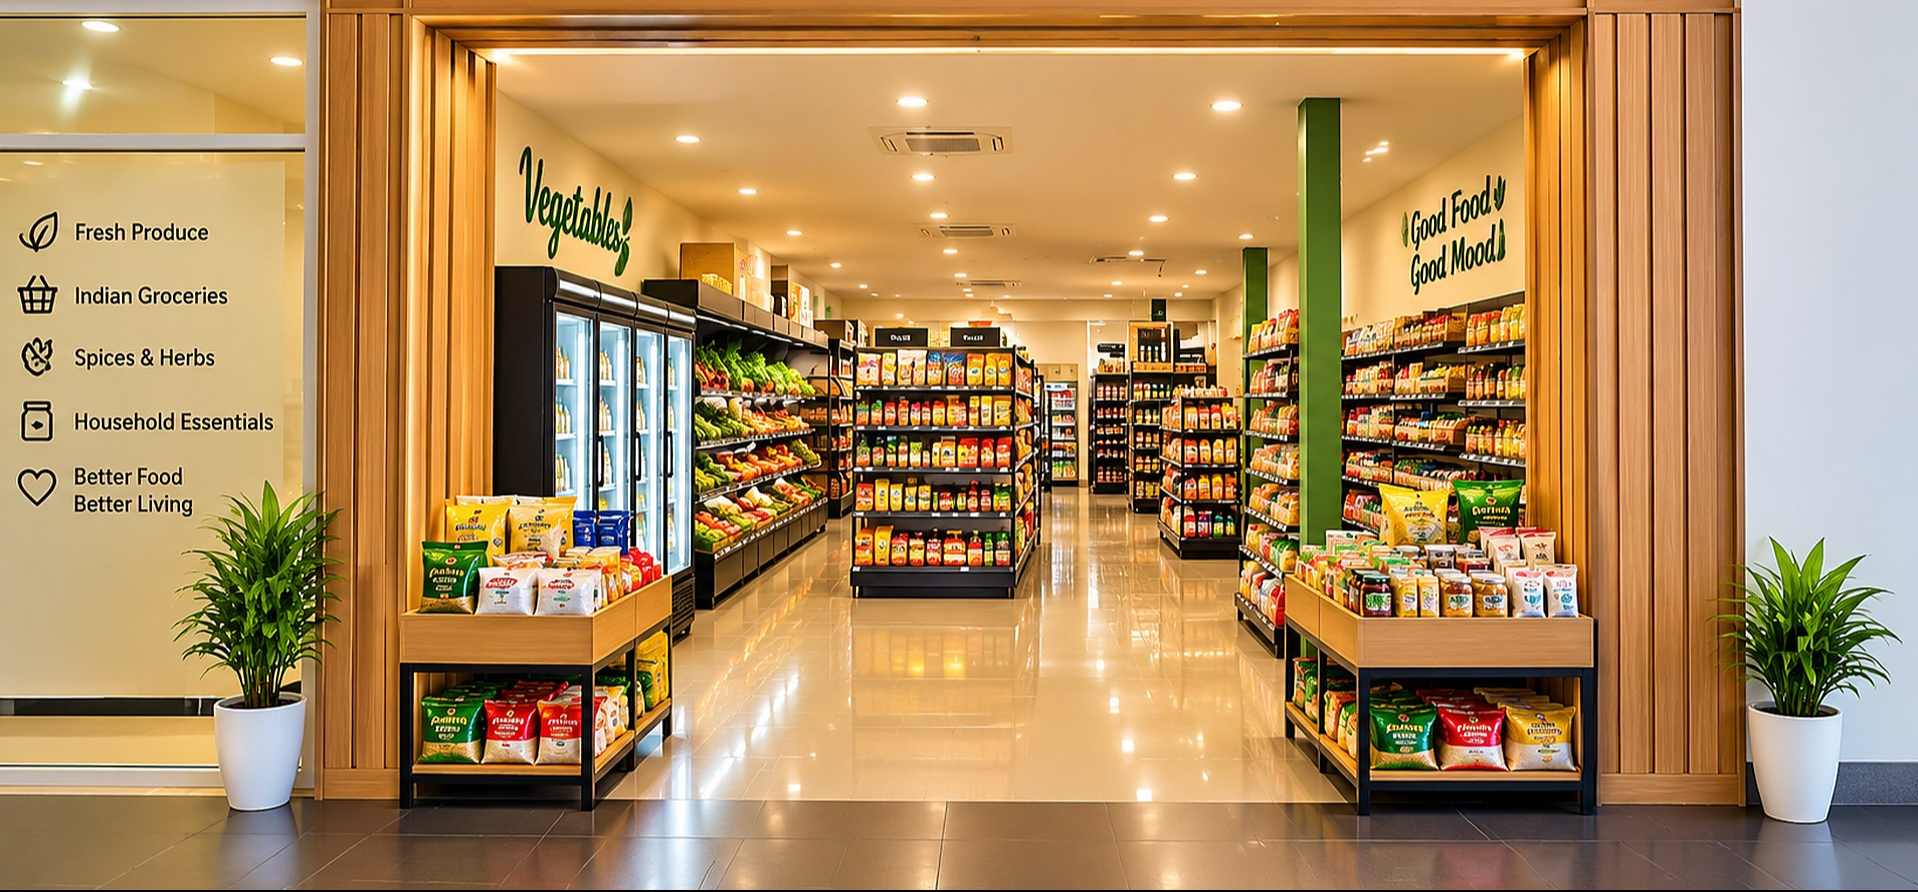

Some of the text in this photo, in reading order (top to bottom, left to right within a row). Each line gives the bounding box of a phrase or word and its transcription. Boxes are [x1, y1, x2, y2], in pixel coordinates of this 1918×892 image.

[519, 146, 624, 259] Vegetables
[1411, 175, 1491, 251] Good Food
[76, 223, 209, 241] Fresh Produce
[1411, 223, 1496, 295] Good Mood
[75, 286, 228, 305] Indian Groceries
[74, 347, 215, 371] Spices & Herbs
[74, 412, 274, 431] Household Essentials
[74, 466, 183, 486] Better Food
[74, 494, 193, 518] Better Living
